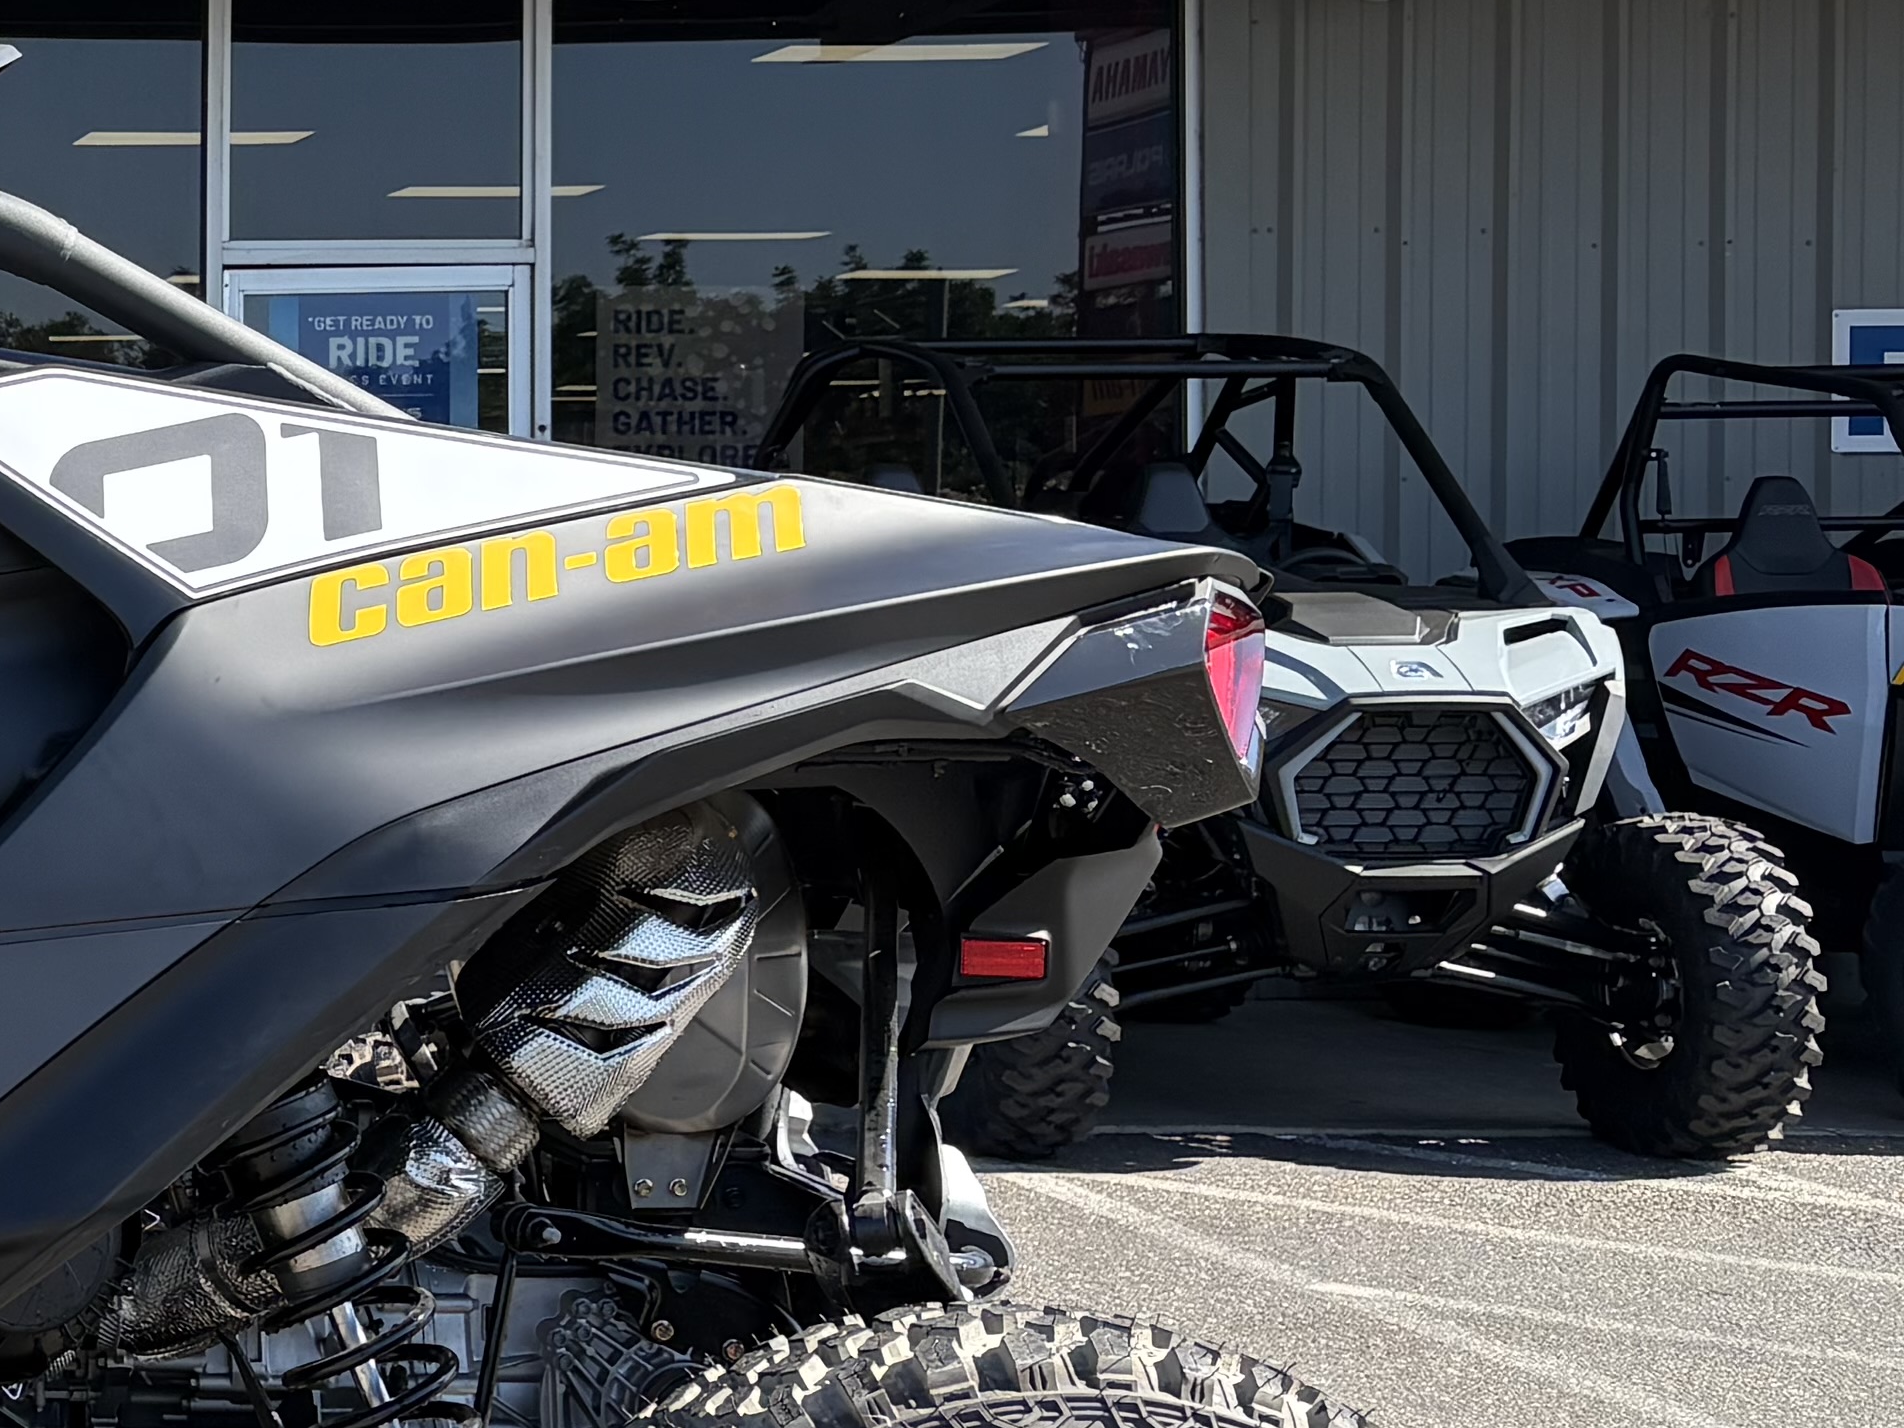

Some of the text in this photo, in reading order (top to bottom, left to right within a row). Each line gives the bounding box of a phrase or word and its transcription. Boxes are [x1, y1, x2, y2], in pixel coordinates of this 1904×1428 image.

[314, 315, 433, 331] GET READY TO
[612, 309, 695, 335] RIDE.
[329, 335, 420, 368] RIDE
[612, 343, 683, 369] REV.
[379, 374, 434, 385] EVENT
[612, 377, 728, 402] CHASE.
[612, 410, 748, 436] GATHER.
[308, 482, 807, 648] can-am
[1664, 648, 1852, 735] RZR
